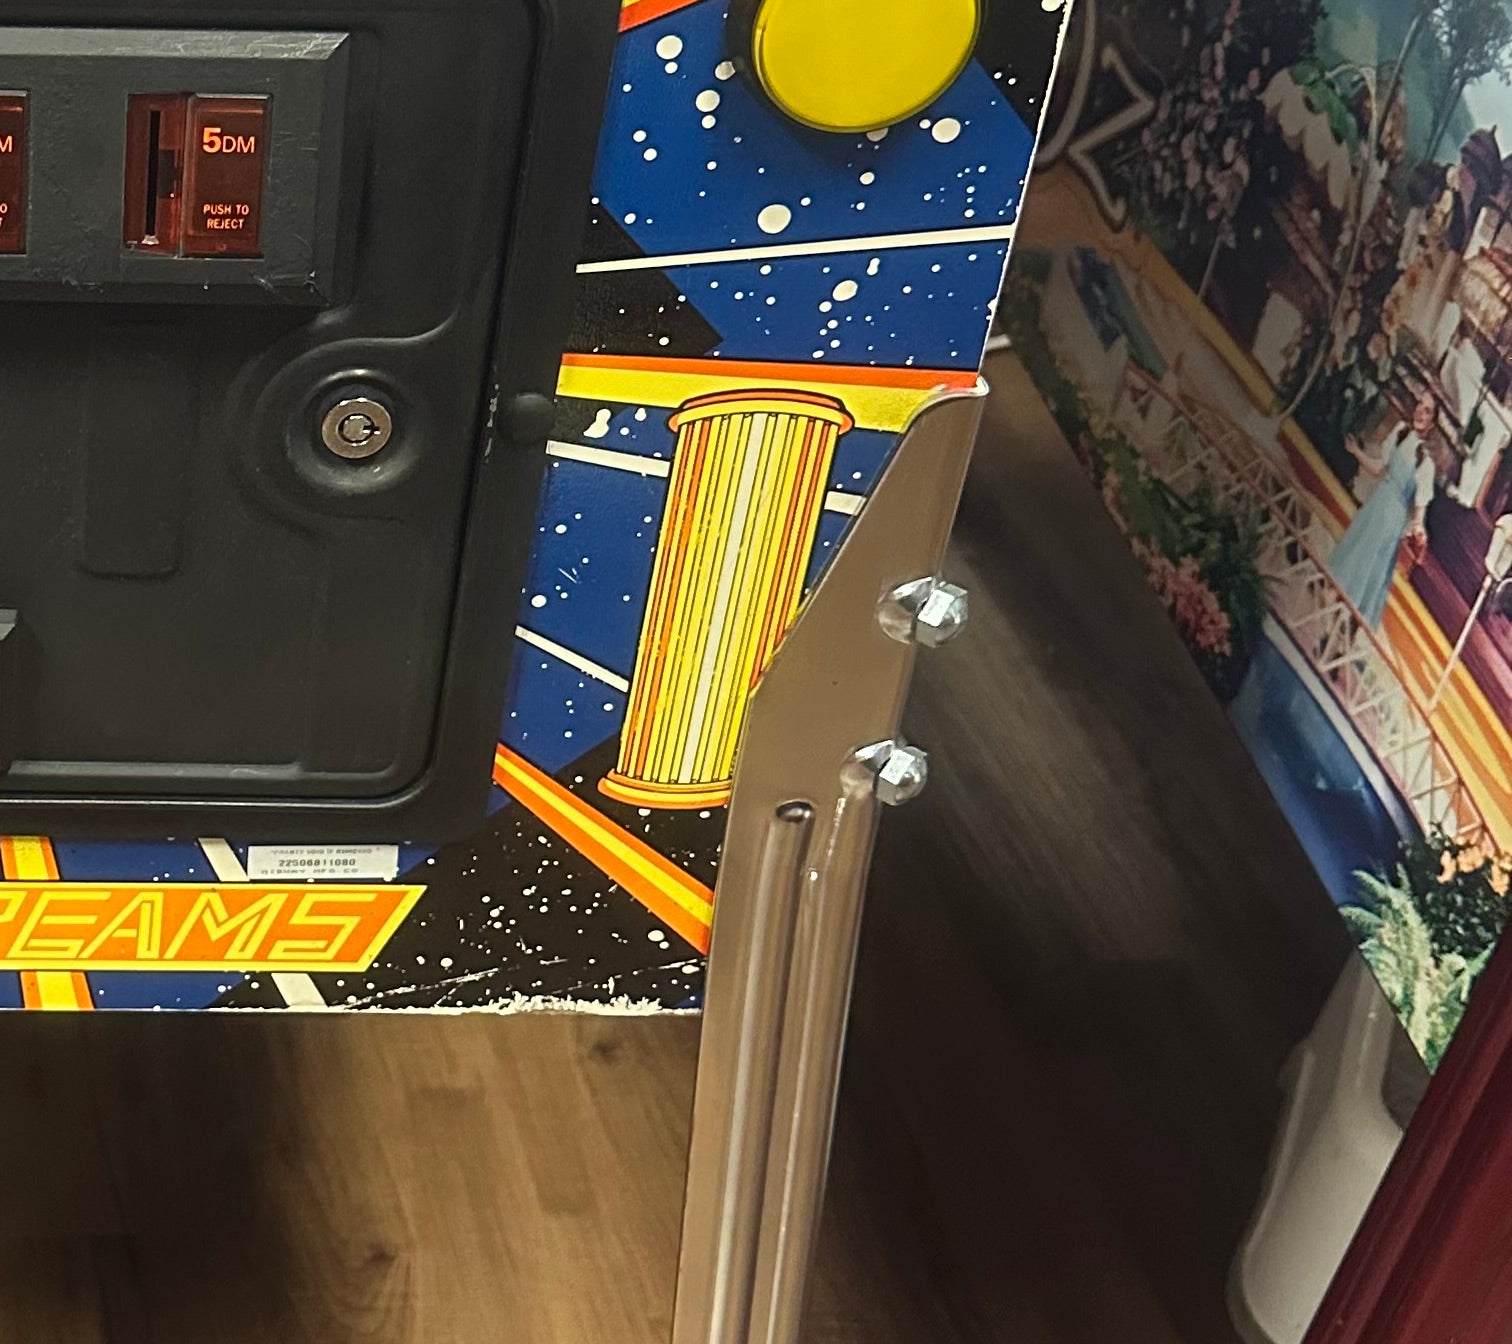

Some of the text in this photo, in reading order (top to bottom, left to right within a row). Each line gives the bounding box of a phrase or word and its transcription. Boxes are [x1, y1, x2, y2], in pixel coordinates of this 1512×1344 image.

[202, 127, 256, 154] 5DM
[203, 204, 249, 215] PUSH TO
[207, 218, 245, 229] REJECT
